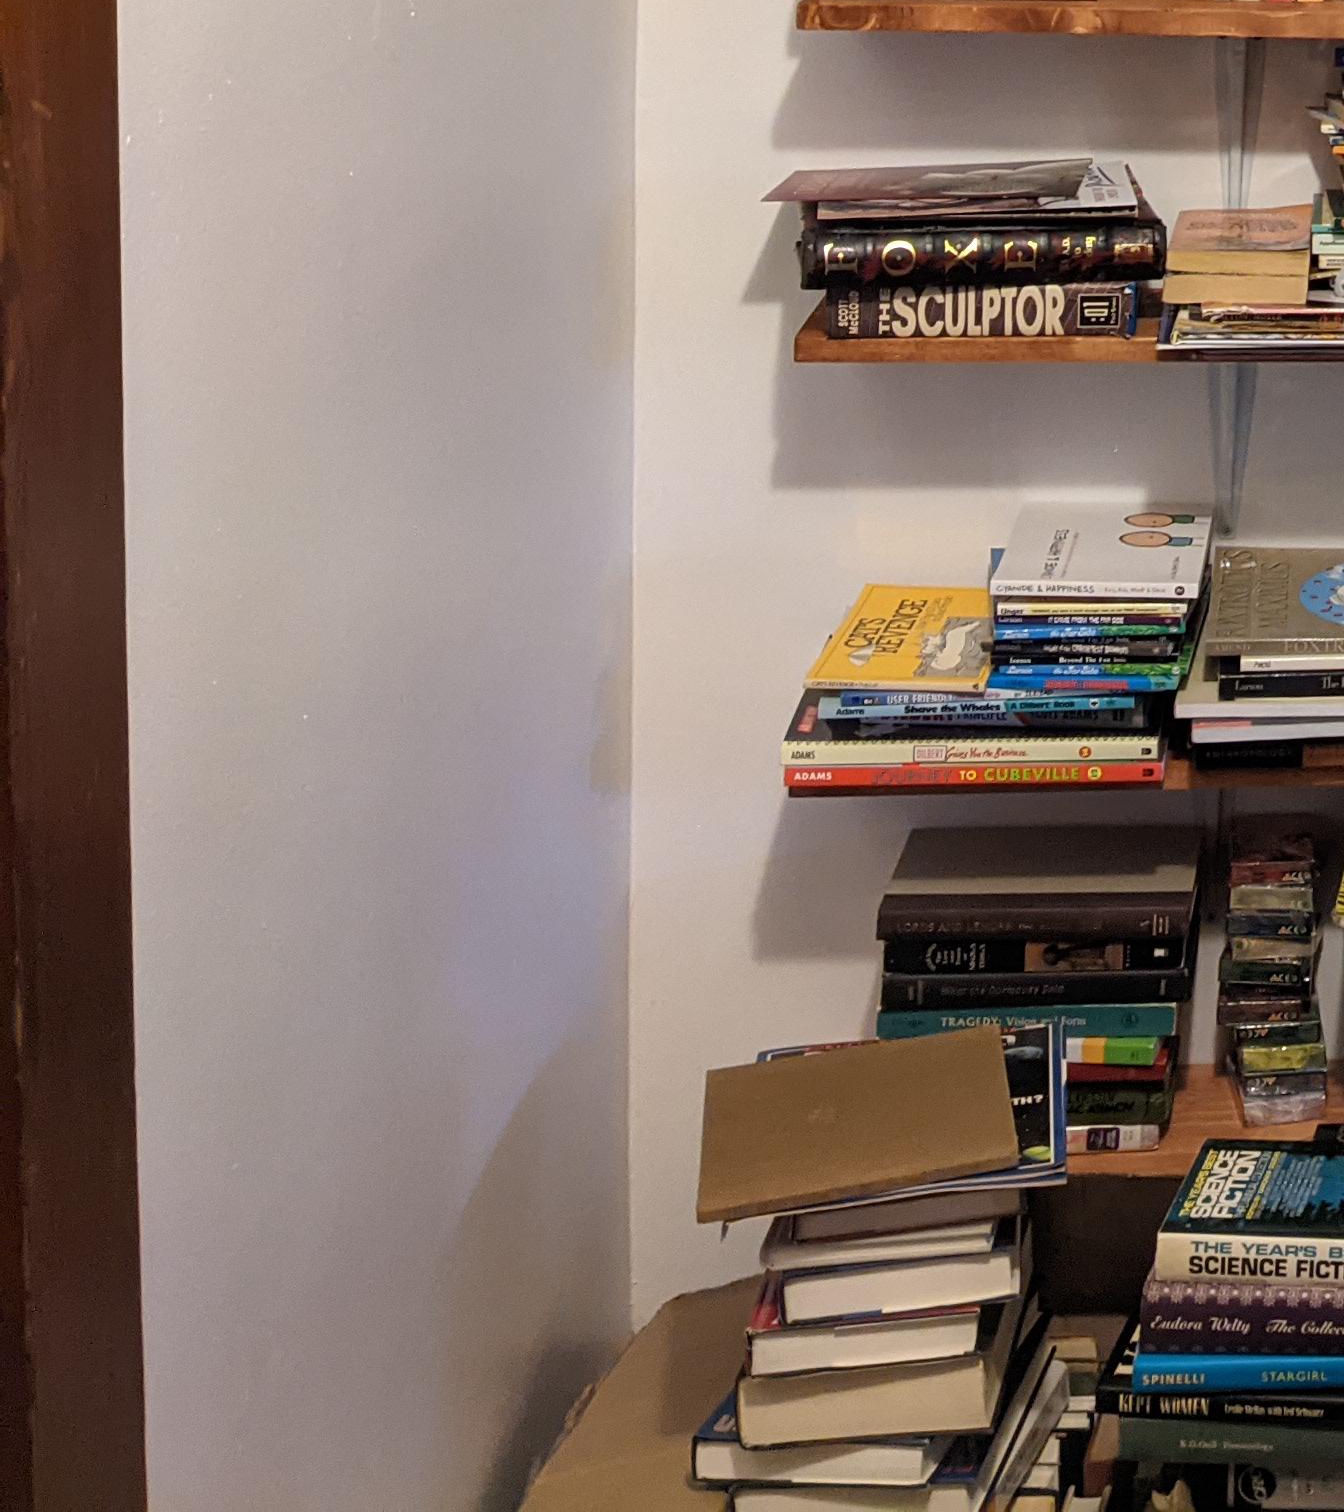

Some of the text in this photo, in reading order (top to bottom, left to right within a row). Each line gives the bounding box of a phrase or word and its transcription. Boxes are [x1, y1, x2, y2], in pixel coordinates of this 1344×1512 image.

[892, 285, 1066, 337] SCULPTOR
[793, 766, 1080, 782] ADAMS TO CUBEVILLE
[1191, 1241, 1238, 1255] THE
[1242, 1243, 1318, 1258] YEAR'S
[1188, 1256, 1288, 1280] SCIENCE
[1150, 1316, 1203, 1332] Eudora
[1141, 1370, 1328, 1386] SPINELLI STARGIRL
